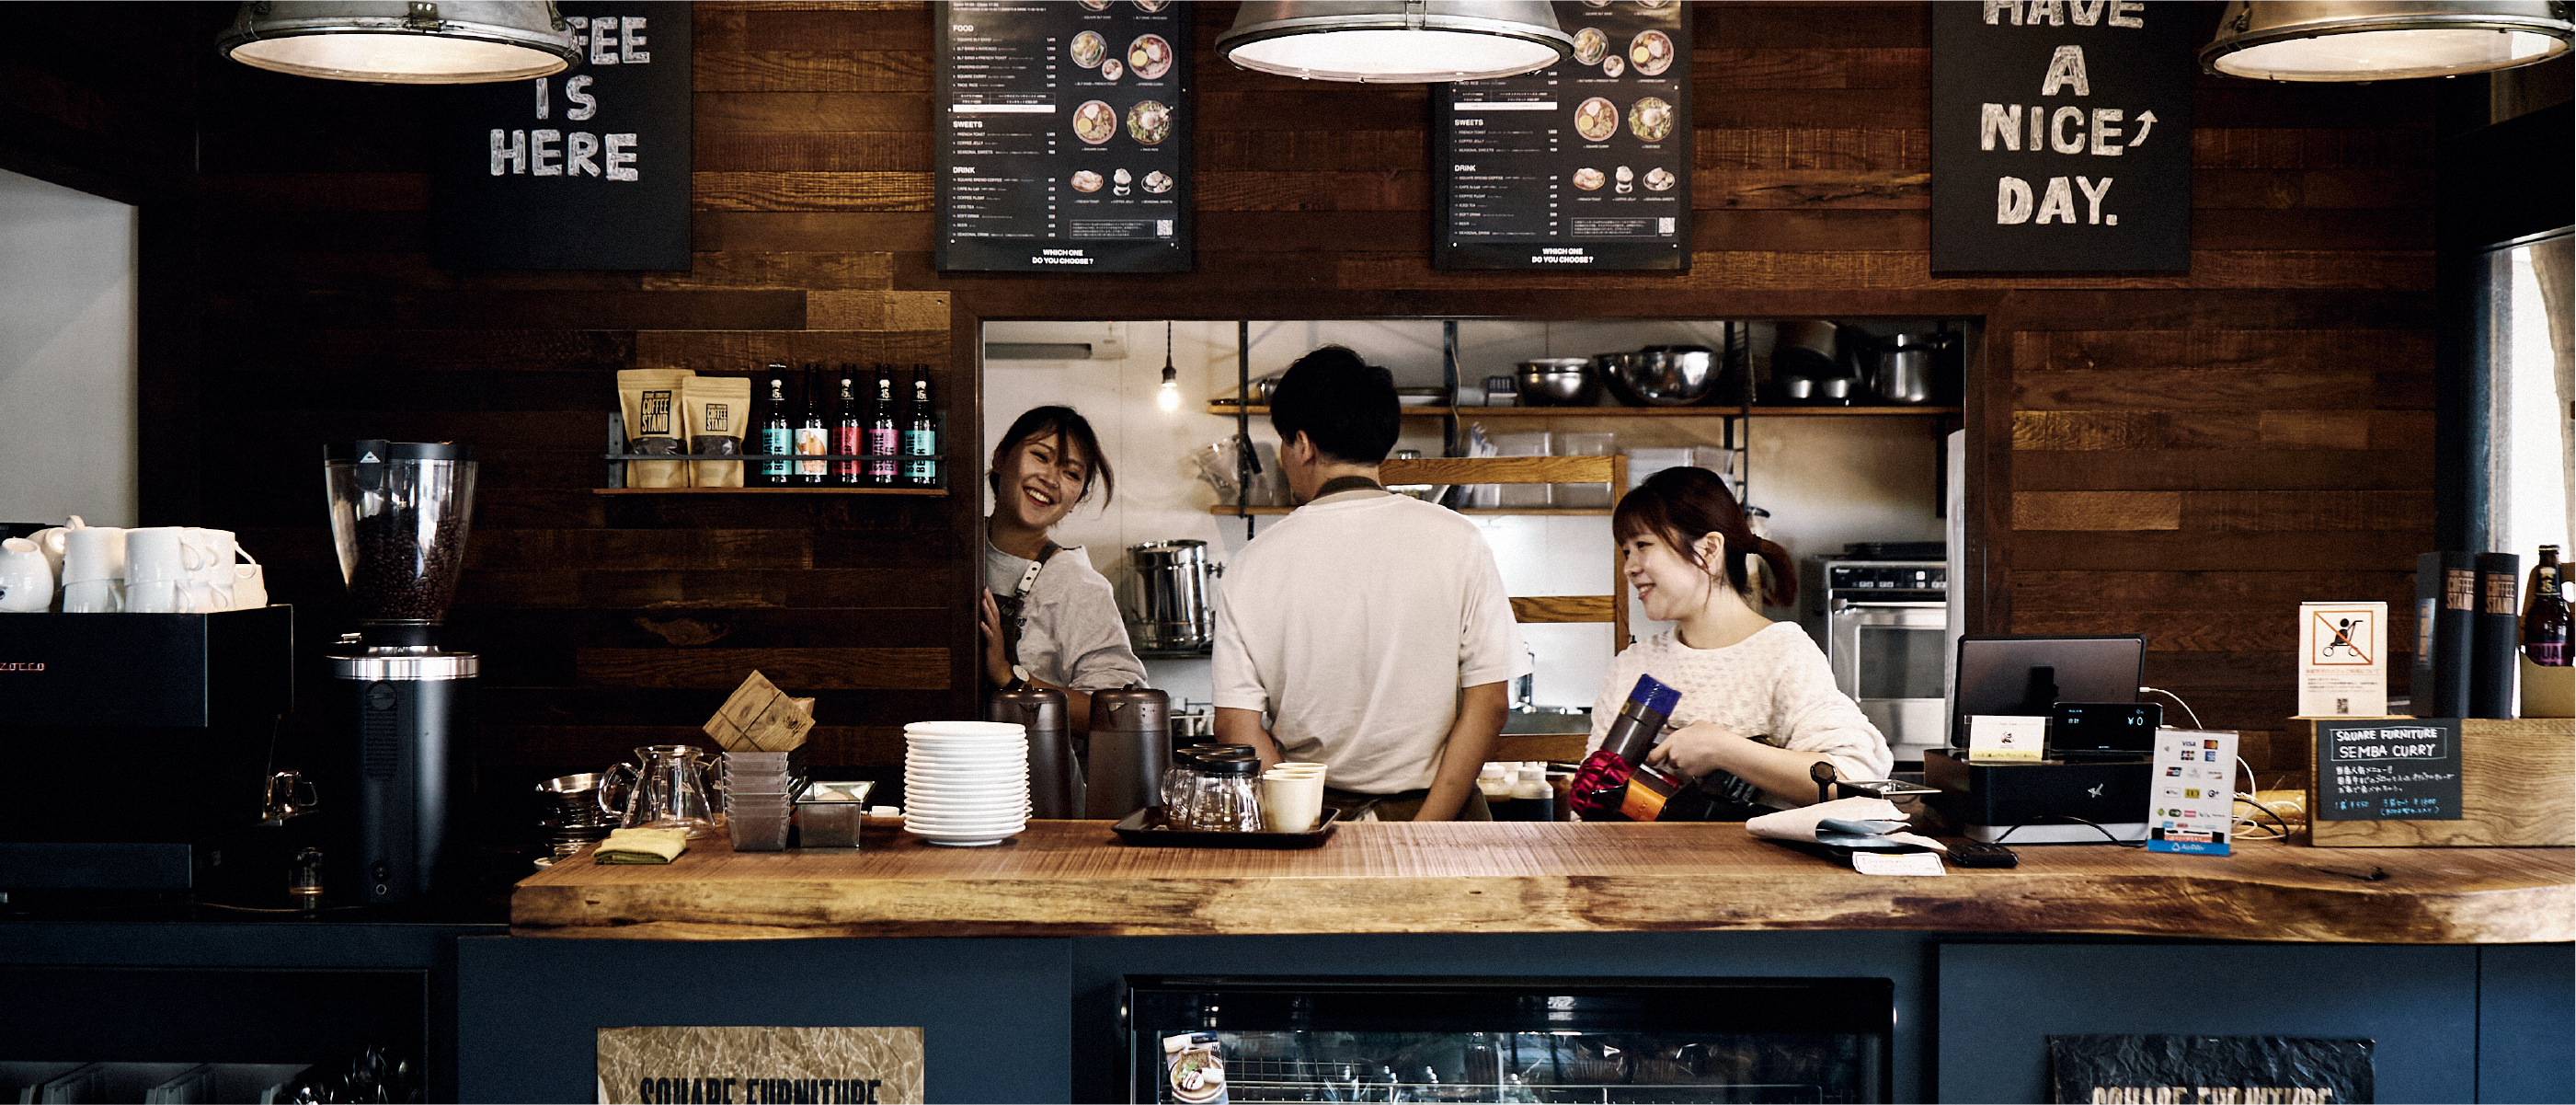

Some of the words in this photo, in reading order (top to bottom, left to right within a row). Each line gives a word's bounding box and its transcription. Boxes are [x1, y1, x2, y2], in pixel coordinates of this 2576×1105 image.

[1983, 0, 2145, 29] HAVE
[2042, 45, 2090, 97] A
[536, 75, 597, 121] IS
[1981, 102, 2124, 156] NICE
[490, 129, 638, 181] HERE
[1997, 176, 2118, 226] DAY.
[643, 398, 670, 414] COFFEE
[707, 409, 727, 420] COFFEE
[642, 414, 669, 432] STAND
[707, 419, 727, 431] STAND
[916, 448, 925, 473] BER
[2336, 730, 2376, 742] SQUARE
[2380, 729, 2438, 740] FURNITURE
[2339, 744, 2388, 759] SEMBA
[2392, 743, 2436, 757] CURRY
